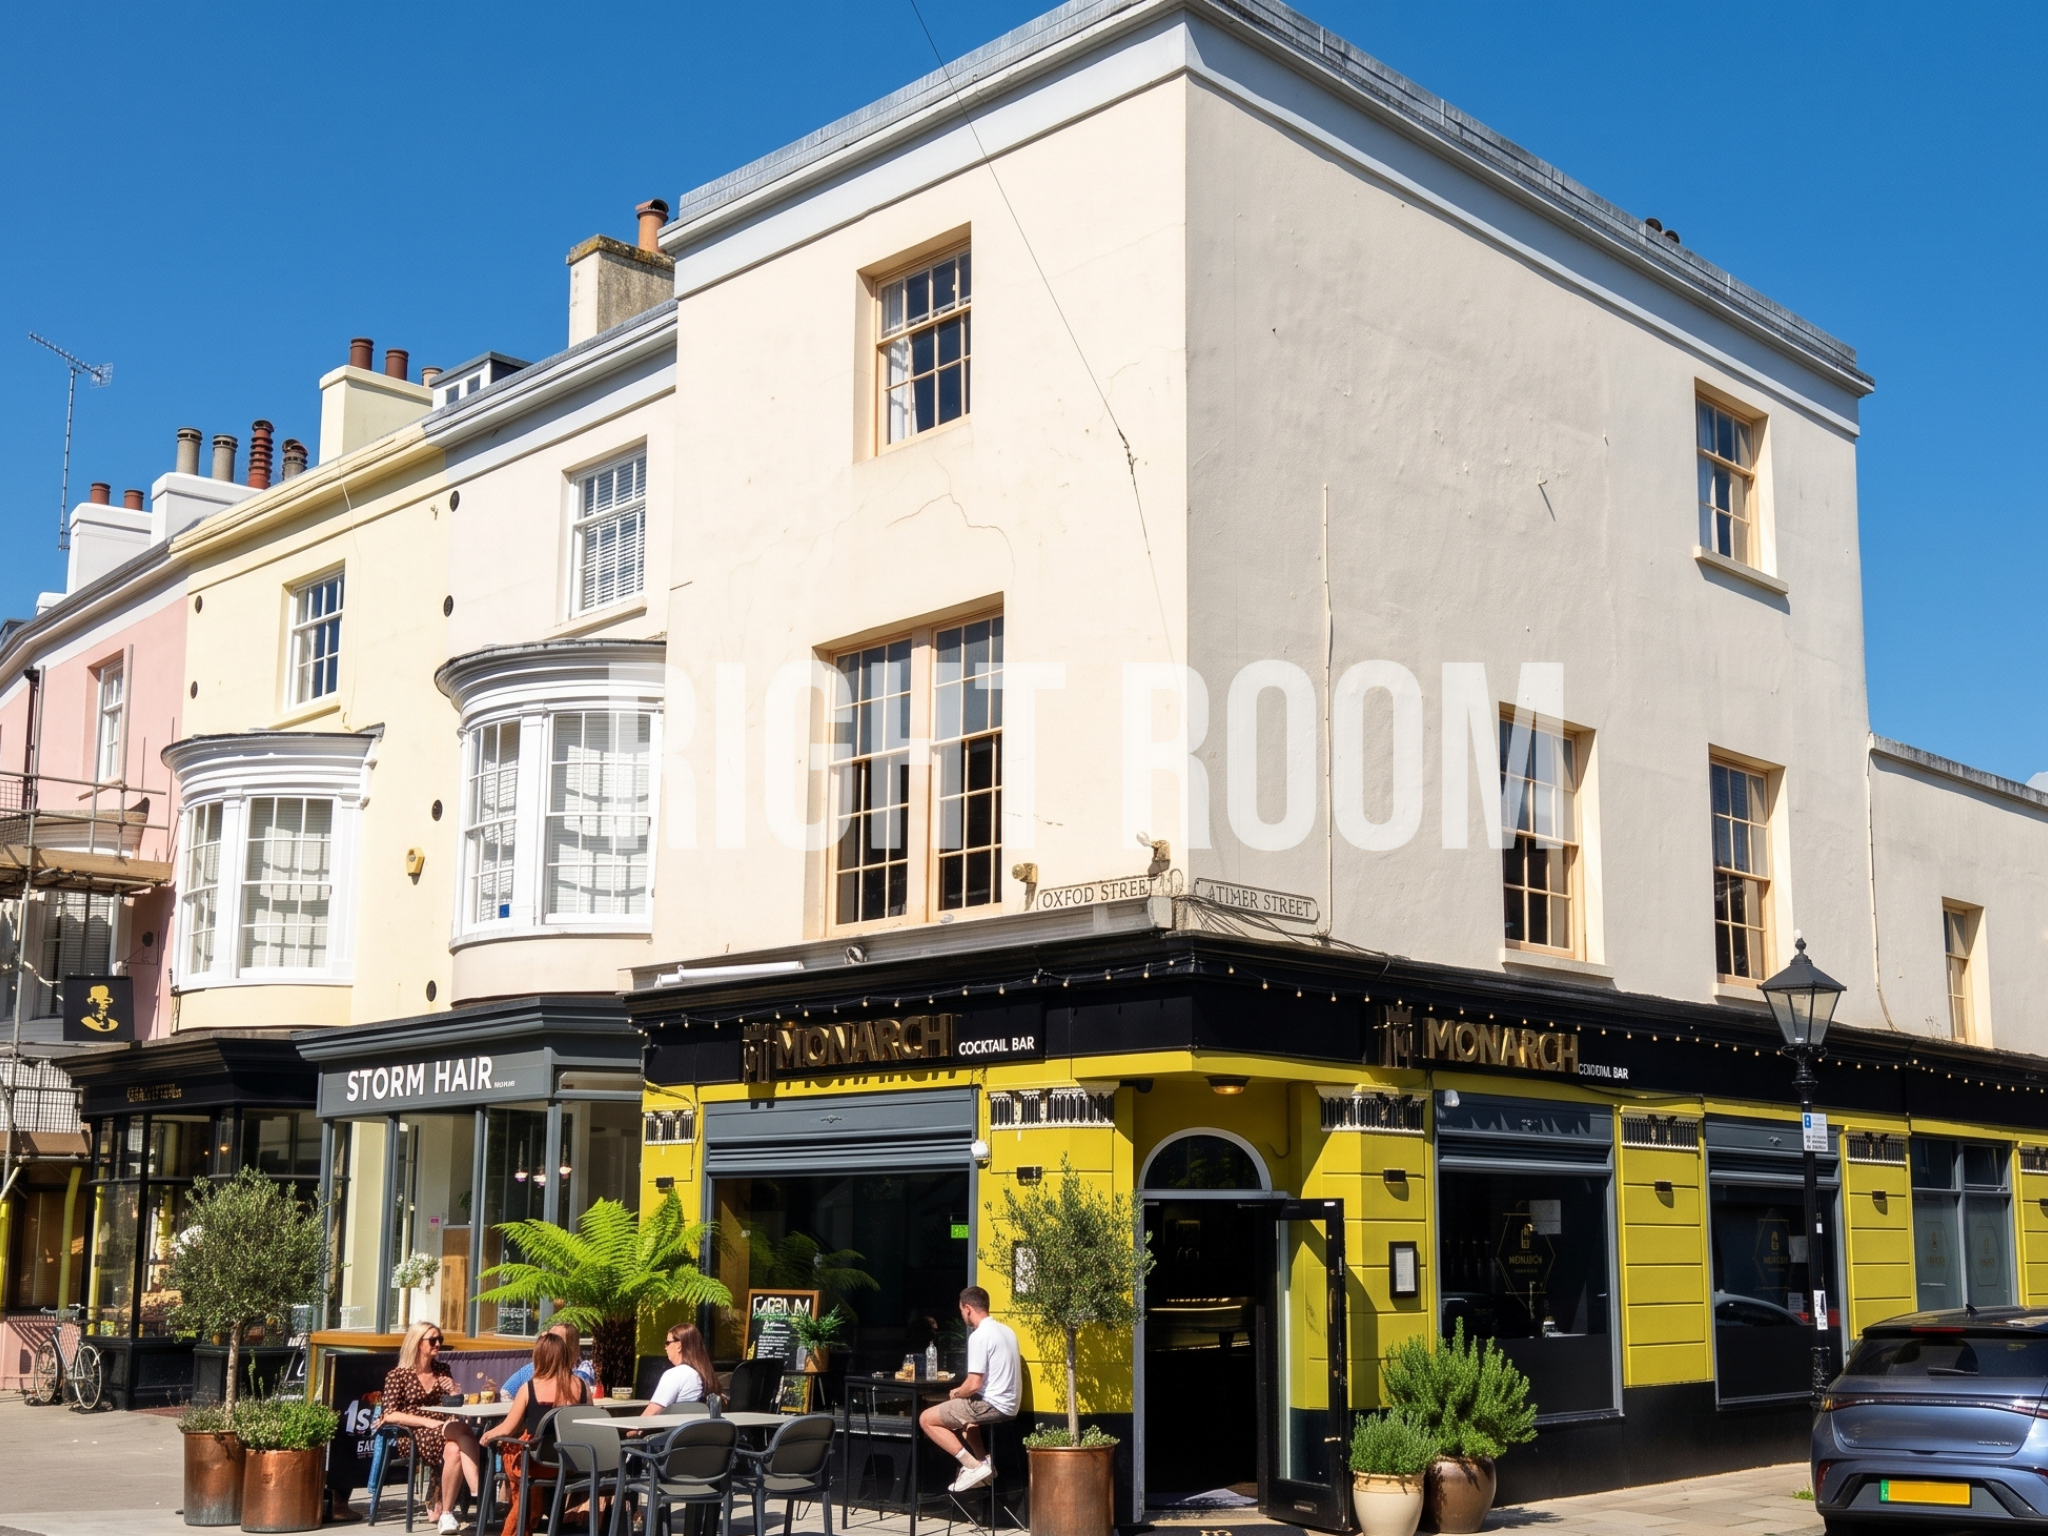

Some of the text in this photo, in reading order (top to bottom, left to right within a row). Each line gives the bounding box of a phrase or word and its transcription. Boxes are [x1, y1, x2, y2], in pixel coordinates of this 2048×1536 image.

[1042, 879, 1154, 909] OXFOD STREET
[1263, 894, 1312, 918] STREET
[775, 1013, 953, 1069] MONARCH
[958, 1036, 1035, 1056] COCKTAIL BAR
[1424, 1018, 1578, 1073] MONARCH
[346, 1056, 493, 1102] STORM HAIR
[1612, 1066, 1629, 1080] BAR
